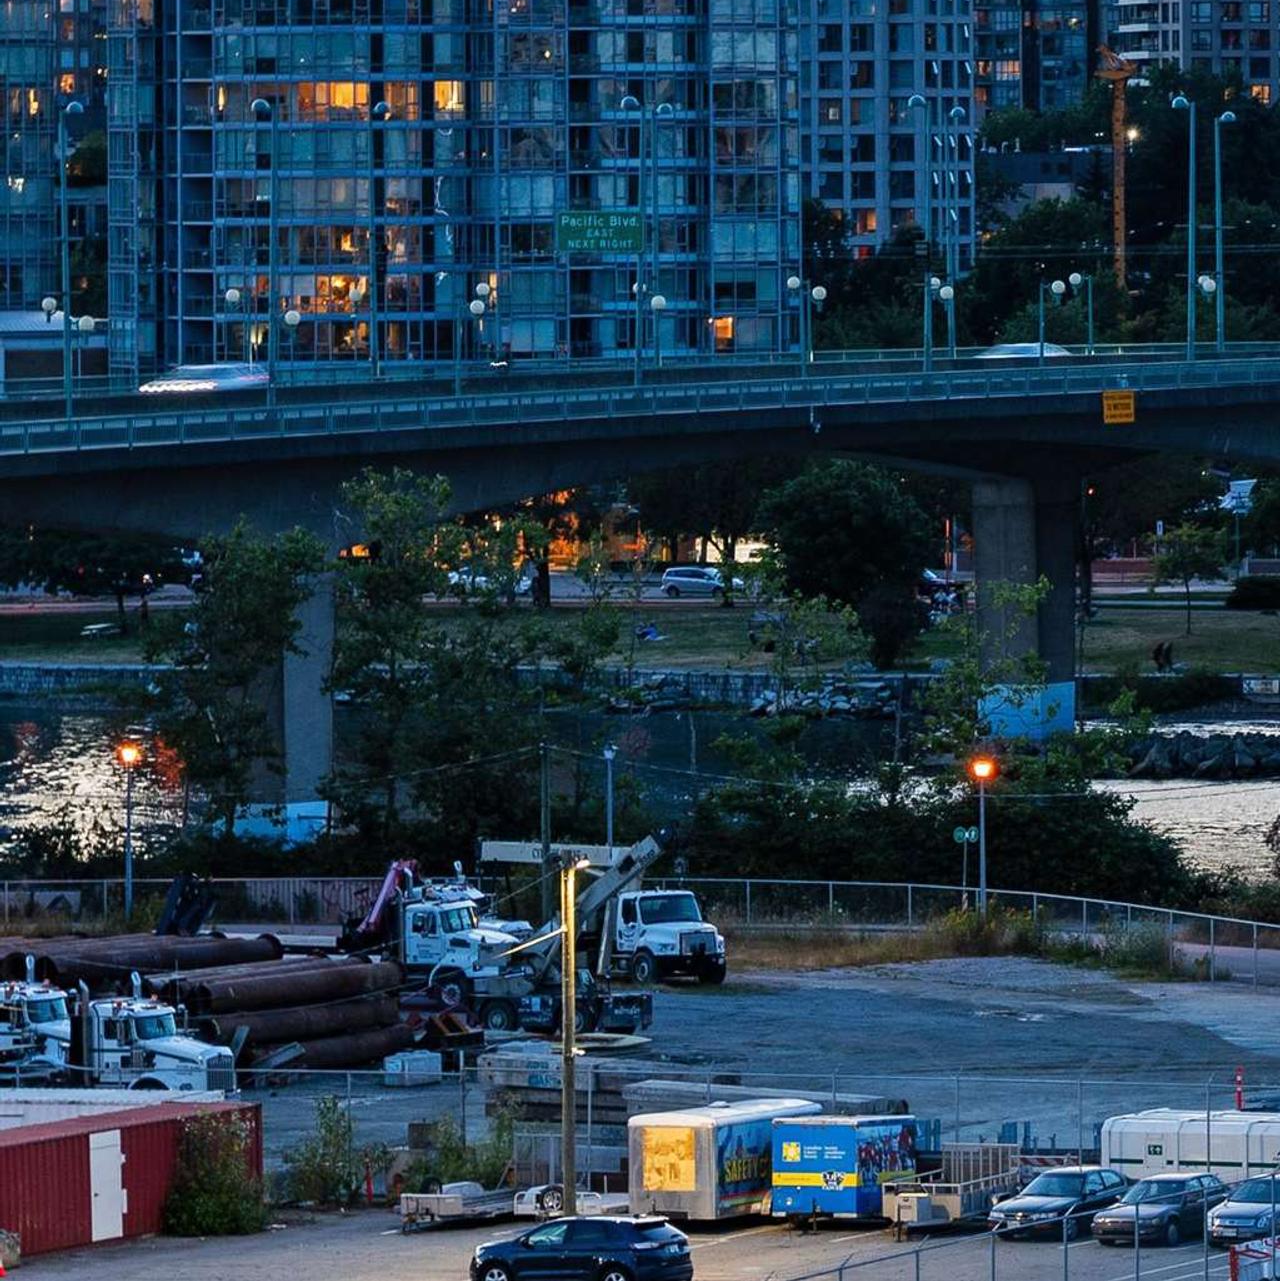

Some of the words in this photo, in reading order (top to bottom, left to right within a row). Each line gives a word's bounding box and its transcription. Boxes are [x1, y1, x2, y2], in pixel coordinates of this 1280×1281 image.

[561, 215, 605, 227] Pacific
[609, 215, 640, 227] Blvd.
[586, 228, 614, 238] EAST
[567, 239, 595, 249] NEXT
[599, 239, 634, 249] RIGHT
